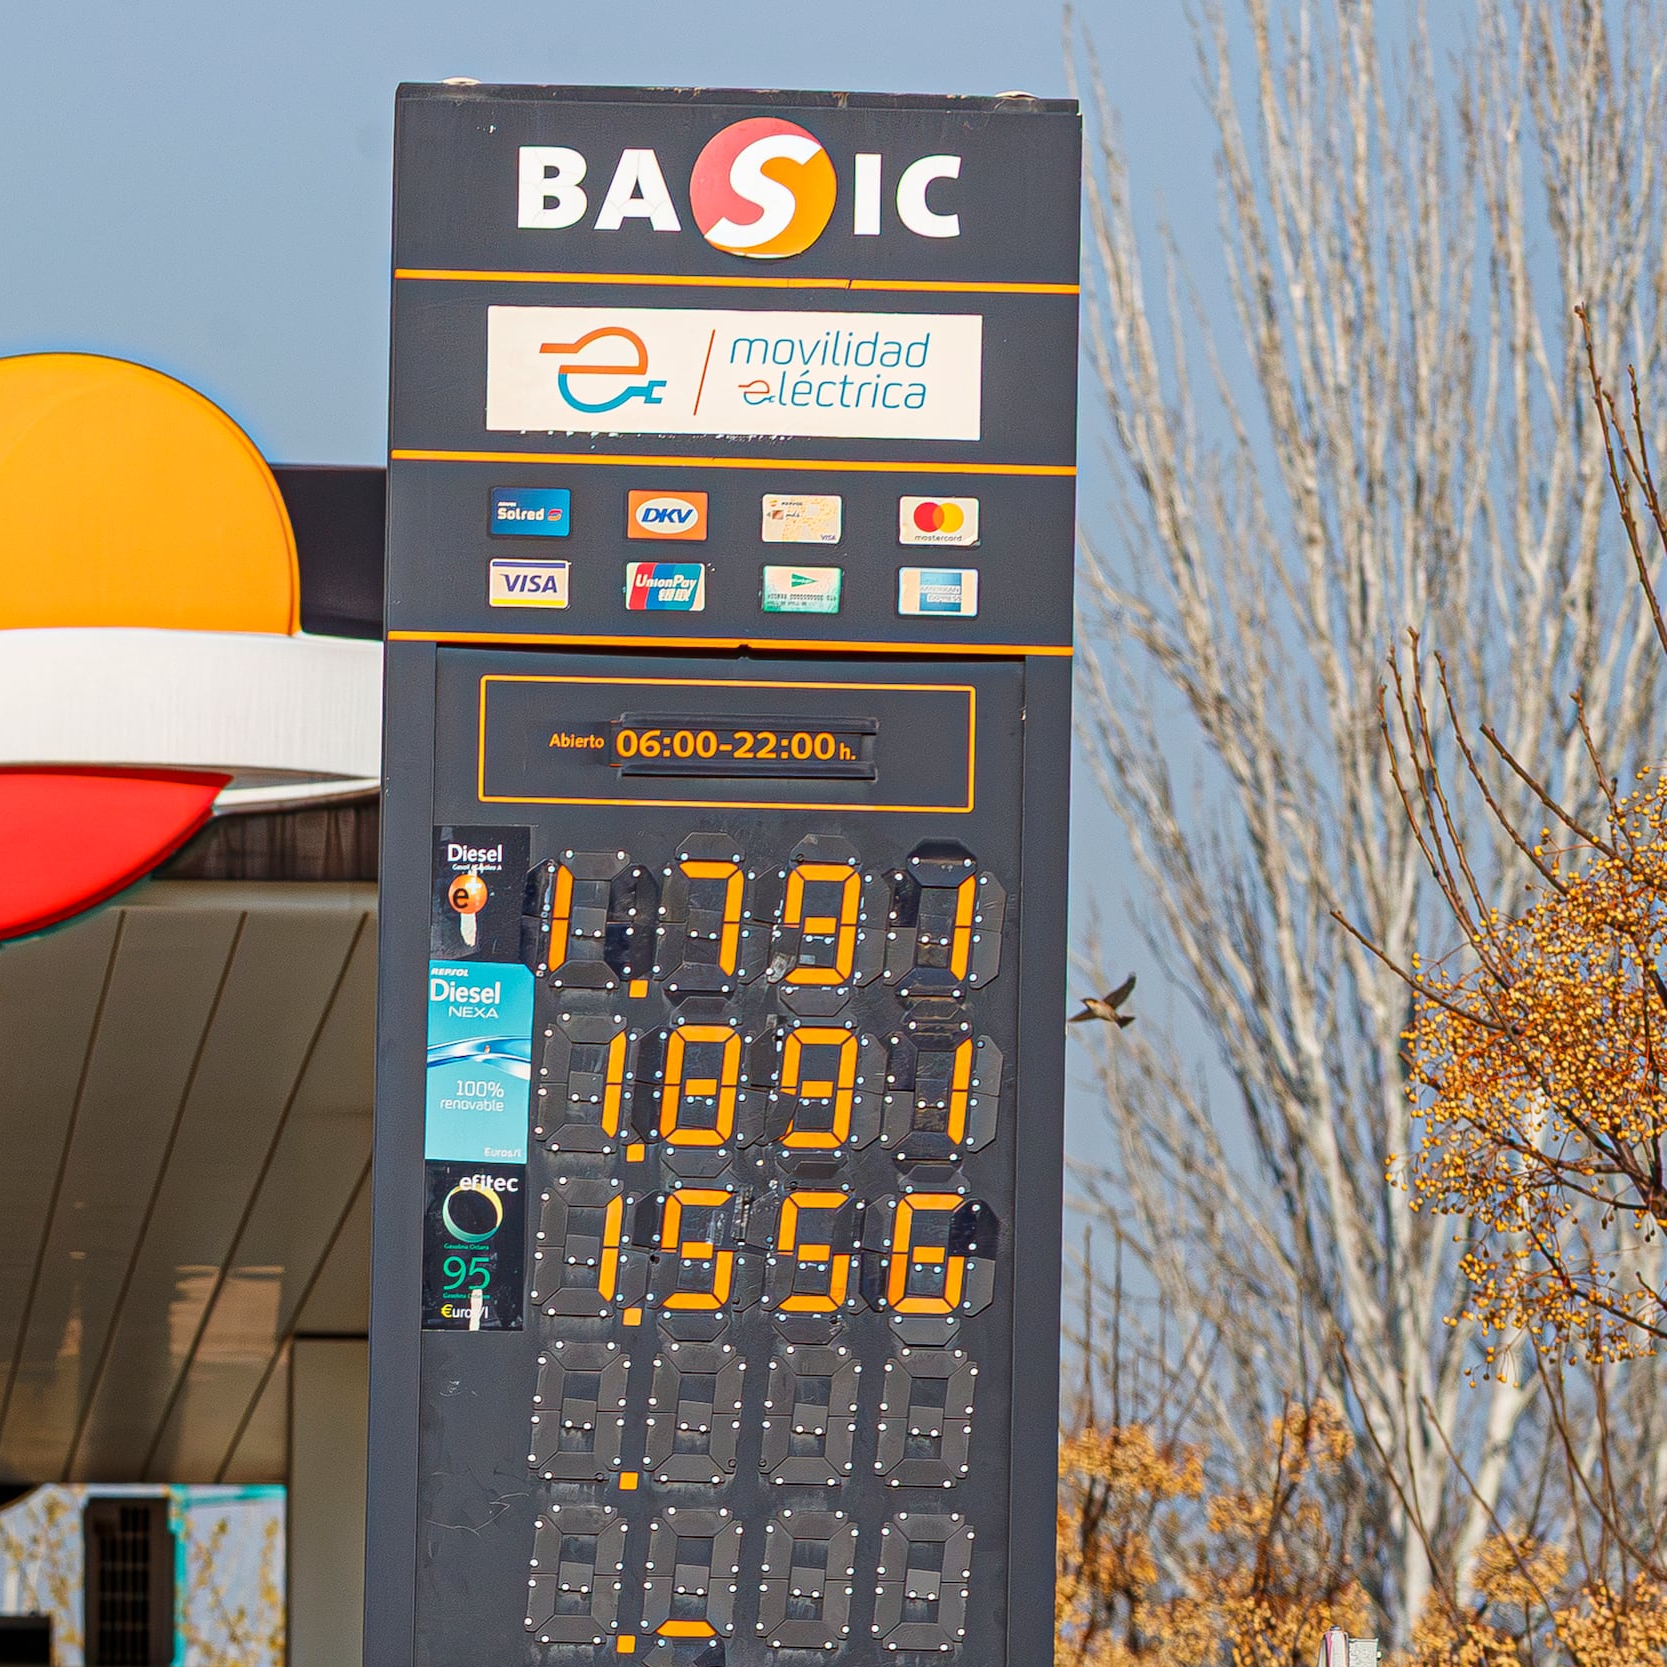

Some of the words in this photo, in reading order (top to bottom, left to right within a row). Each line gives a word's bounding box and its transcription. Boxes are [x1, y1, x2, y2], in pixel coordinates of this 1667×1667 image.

[518, 134, 961, 247] BASIC
[730, 330, 930, 368] movilidad
[738, 372, 926, 410] eléctrica
[497, 508, 544, 521] Solred
[641, 507, 694, 524] DKV
[500, 574, 558, 594] VISA
[635, 574, 697, 592] UnionPay
[549, 731, 604, 750] Abierto
[615, 730, 836, 761] 06:00-22:00
[447, 843, 502, 862] Diesel
[430, 967, 469, 977] REPSOL
[430, 978, 501, 1004] Diesel
[448, 1006, 499, 1019] NEXA
[456, 1080, 505, 1098] 100%
[440, 1099, 504, 1112] renovable
[459, 1174, 518, 1192] efitec
[443, 1256, 491, 1290] 95
[441, 1304, 489, 1319] €uro/l
